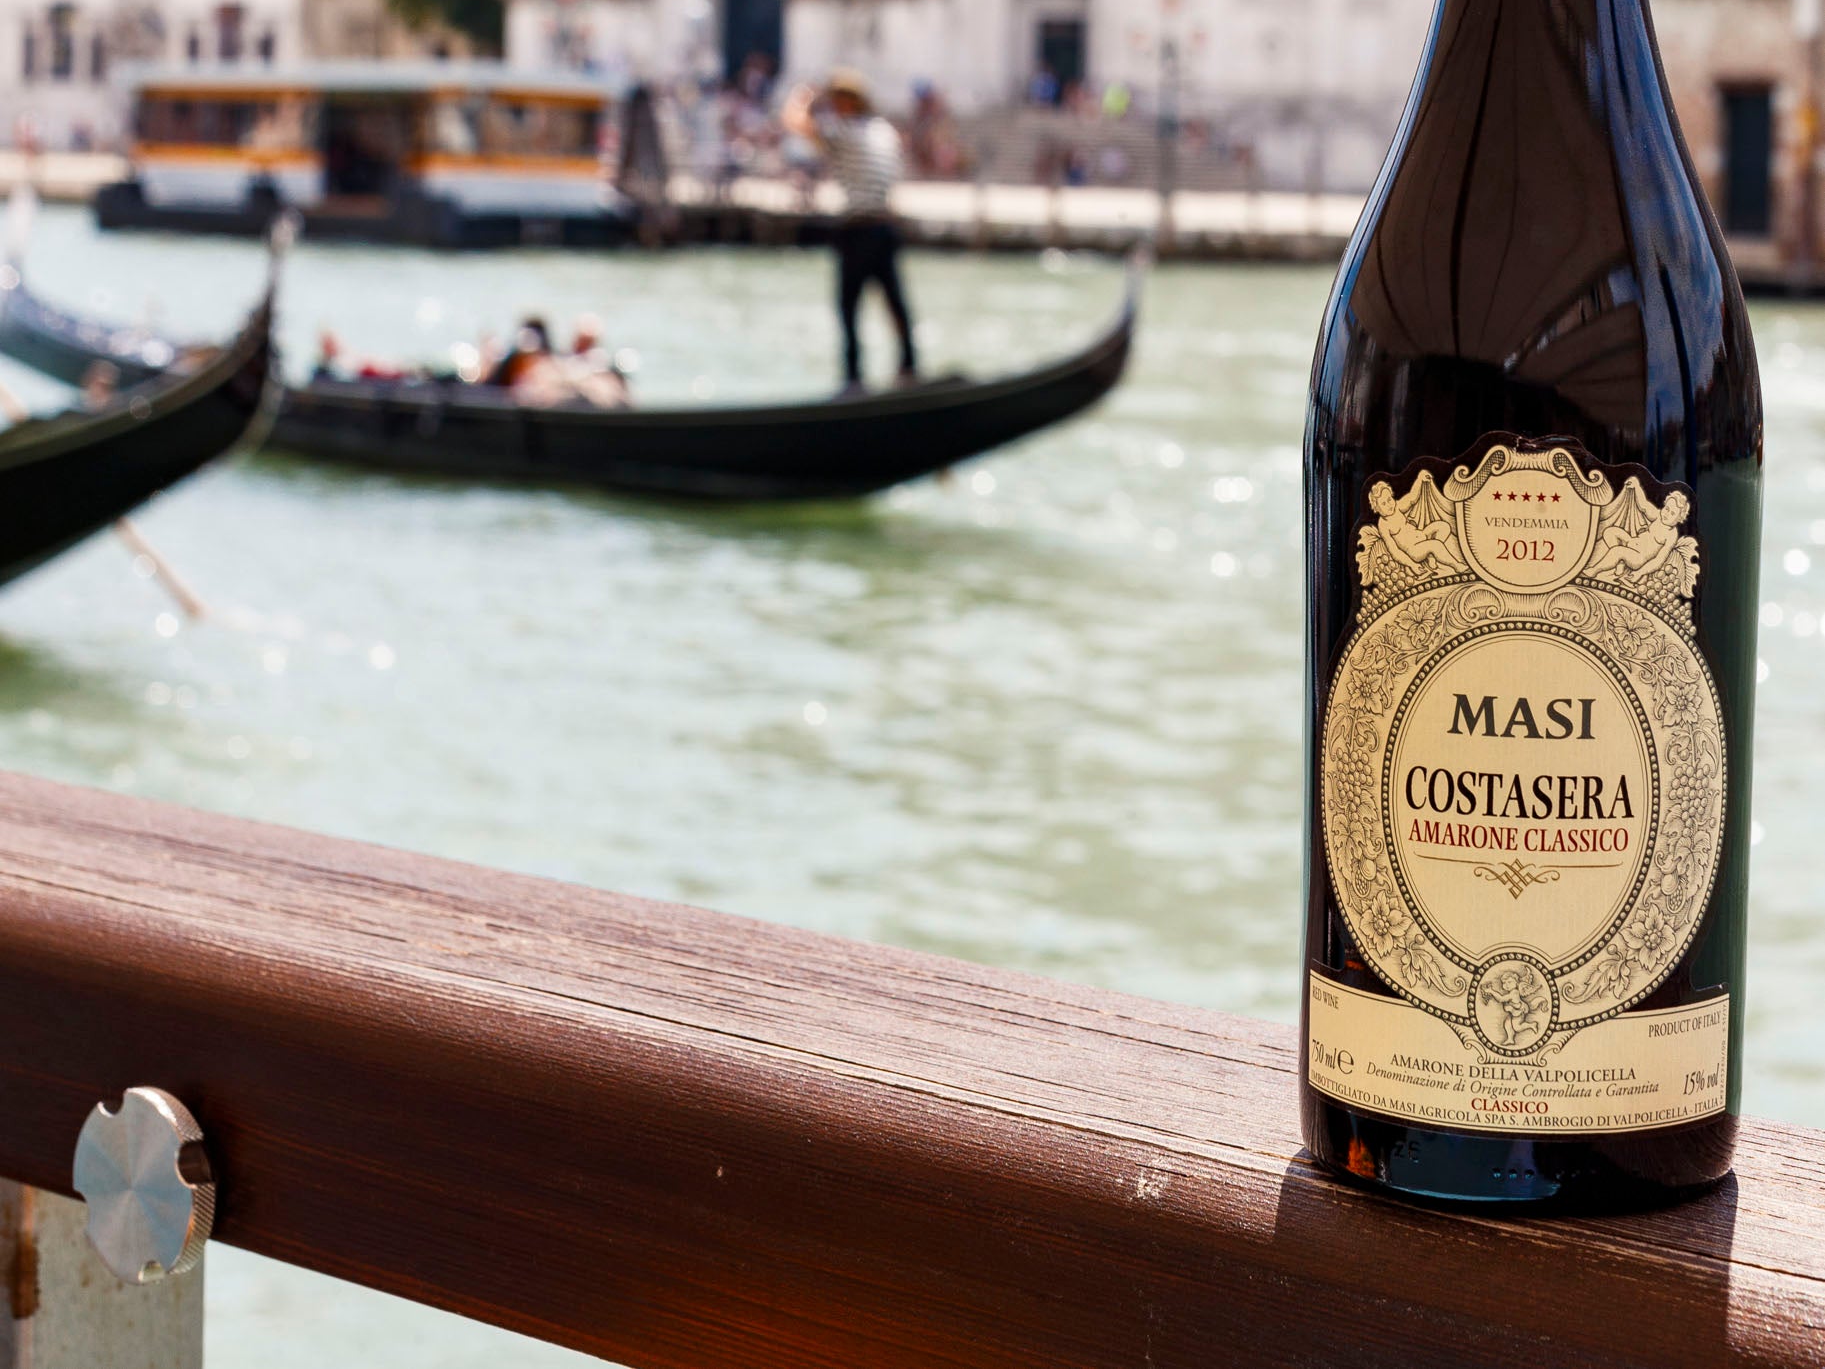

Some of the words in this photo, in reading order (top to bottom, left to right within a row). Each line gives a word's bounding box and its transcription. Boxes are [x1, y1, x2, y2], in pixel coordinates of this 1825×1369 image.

[1484, 516, 1569, 529] VENDEMMIA
[1496, 538, 1555, 562] 2012
[1446, 693, 1596, 740] MASI
[1405, 765, 1635, 820] COSTASERA
[1408, 818, 1518, 851] AMARONE
[1524, 827, 1629, 853] CLASSICO
[1312, 985, 1322, 1001] RED
[1323, 992, 1339, 1009] WINE
[1648, 1021, 1690, 1038] PRODUCT
[1692, 1017, 1702, 1029] OF
[1703, 1011, 1721, 1028] ITALY
[1311, 1039, 1324, 1064] 750
[1366, 1061, 1450, 1090] Denominazione
[1452, 1080, 1465, 1092] di
[1470, 1080, 1518, 1099] Origine
[1522, 1083, 1592, 1098] Controllata
[1595, 1089, 1602, 1097] e
[1606, 1081, 1659, 1097] Garantita
[1390, 1054, 1464, 1077] AMARONE
[1469, 1066, 1519, 1081] DELLA
[1523, 1067, 1637, 1082] VALPOLICELLA
[1682, 1070, 1705, 1096] 15%
[1706, 1062, 1720, 1089] vol
[1311, 1069, 1370, 1102] IMBOTTIGLIATO
[1373, 1094, 1387, 1107] DA
[1389, 1098, 1416, 1114] MASI
[1418, 1107, 1481, 1123] AGRICOLA
[1485, 1113, 1506, 1125] SPA
[1509, 1115, 1519, 1126] S.
[1522, 1115, 1594, 1127] AMBROGIO
[1597, 1114, 1613, 1126] DI
[1614, 1108, 1688, 1125] VALPOLICELLA
[1694, 1098, 1719, 1113] ITALIA
[1471, 1098, 1549, 1114] CLASSICO
